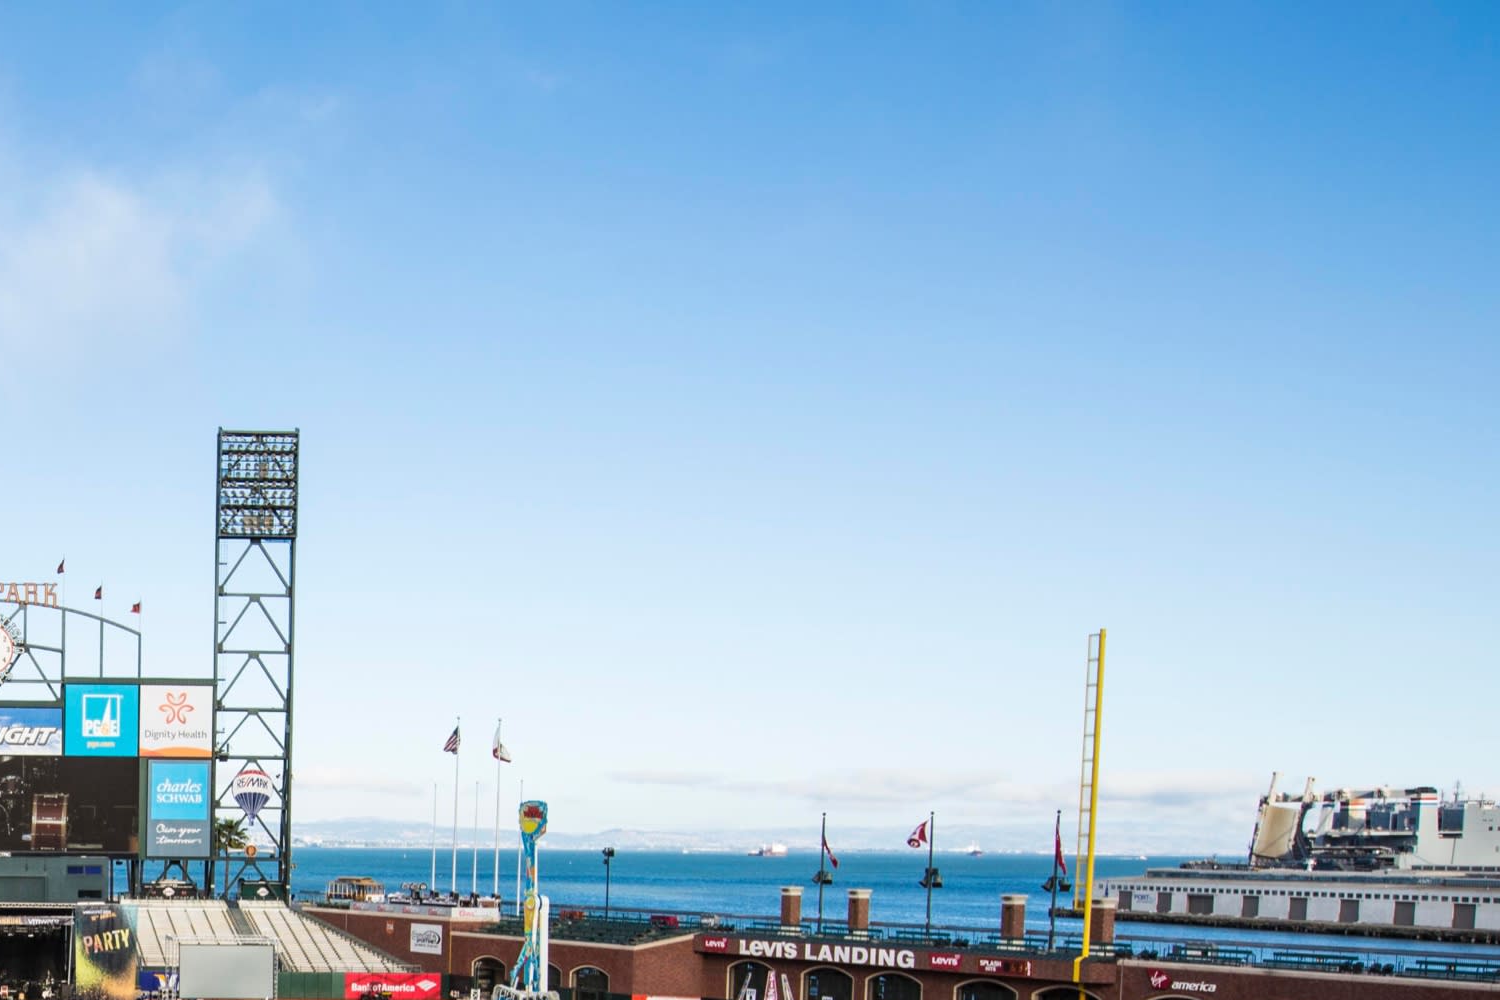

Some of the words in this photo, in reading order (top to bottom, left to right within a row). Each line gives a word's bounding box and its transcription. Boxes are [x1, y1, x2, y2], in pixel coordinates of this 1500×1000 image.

[144, 730, 176, 740] Dignity
[178, 729, 208, 740] Health
[156, 779, 203, 793] charles
[236, 777, 269, 790] RE/MAX
[156, 794, 203, 805] SCHWAB
[83, 928, 130, 953] PARTY
[804, 944, 915, 968] LANDING
[979, 960, 1002, 968] SPLASH
[1150, 971, 1168, 988] Virgin
[382, 983, 415, 992] America
[1171, 981, 1217, 993] america
